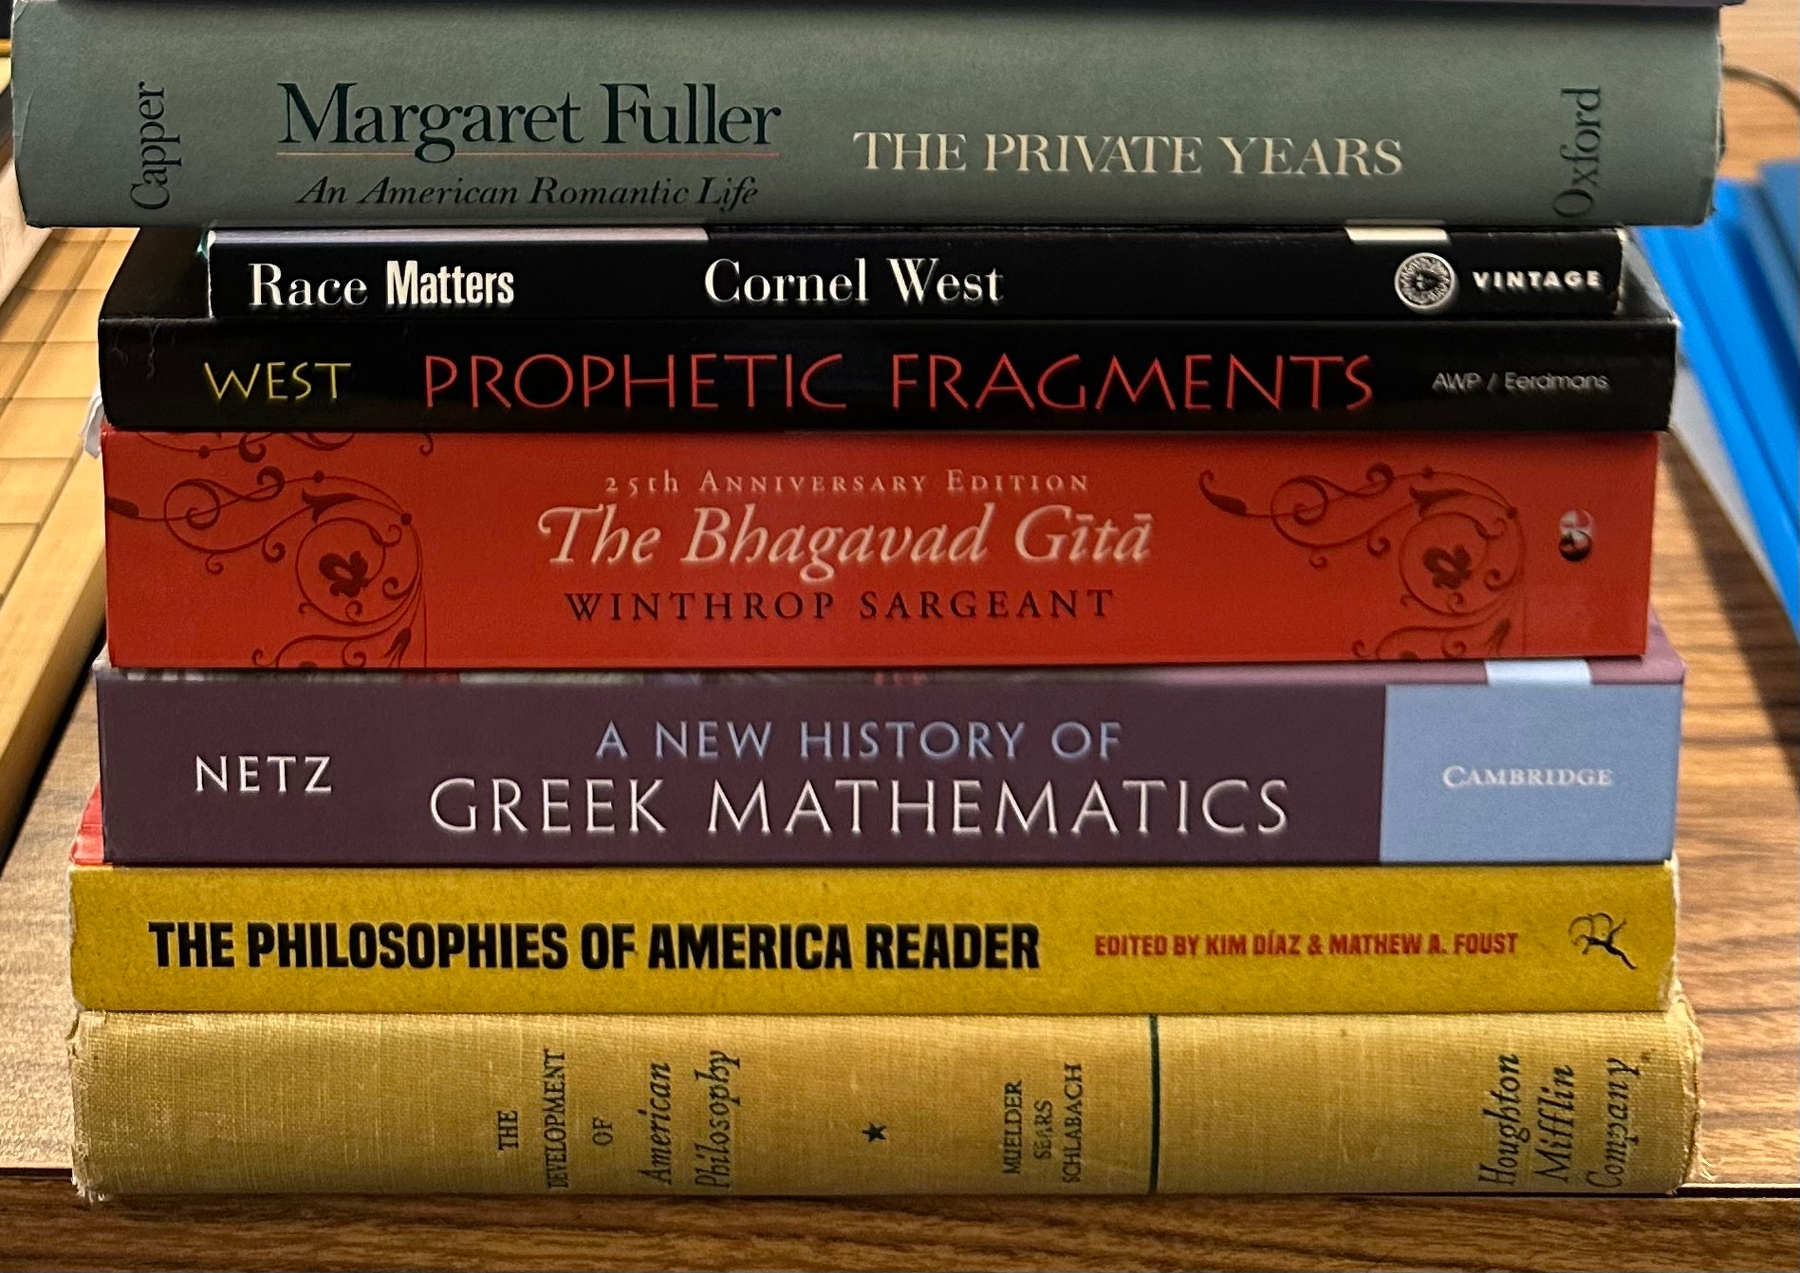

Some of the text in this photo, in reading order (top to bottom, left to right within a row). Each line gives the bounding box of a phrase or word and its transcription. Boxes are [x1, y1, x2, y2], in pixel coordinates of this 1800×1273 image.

[853, 132, 1401, 176] THE PRIVATE YEARS
[249, 258, 998, 306] Race Matters Cornel West
[1473, 271, 1600, 289] VINTAGE
[204, 353, 1372, 410] WEST PROPHETIC FRAGMENTS
[606, 469, 1087, 495] 25th ANNIVERSARY EDITION
[538, 504, 660, 564] The
[681, 504, 993, 585] Bhagavad
[196, 756, 331, 793] NETZ
[1443, 766, 1613, 788] CAMBRIDGE
[431, 778, 1286, 835] GREEK MATHEMATICS
[149, 922, 1039, 970] THE PHILOSOPHIES OF AMERICA READER
[1095, 930, 1518, 957] EDITED BY KIM DÍAZ & MATHEW A. FOUST
[497, 1111, 519, 1151] THE
[546, 1049, 570, 1190] DEVELOPMENT
[592, 1117, 613, 1146] OF
[638, 1062, 673, 1187] American
[693, 1049, 744, 1190] Philosophy
[1002, 1081, 1024, 1175] MUELDER
[1062, 1063, 1084, 1184] SCHLABACH
[1477, 1053, 1532, 1187] Houghton
[1533, 1064, 1574, 1184] Mifflin
[1587, 1057, 1642, 1190] Company
